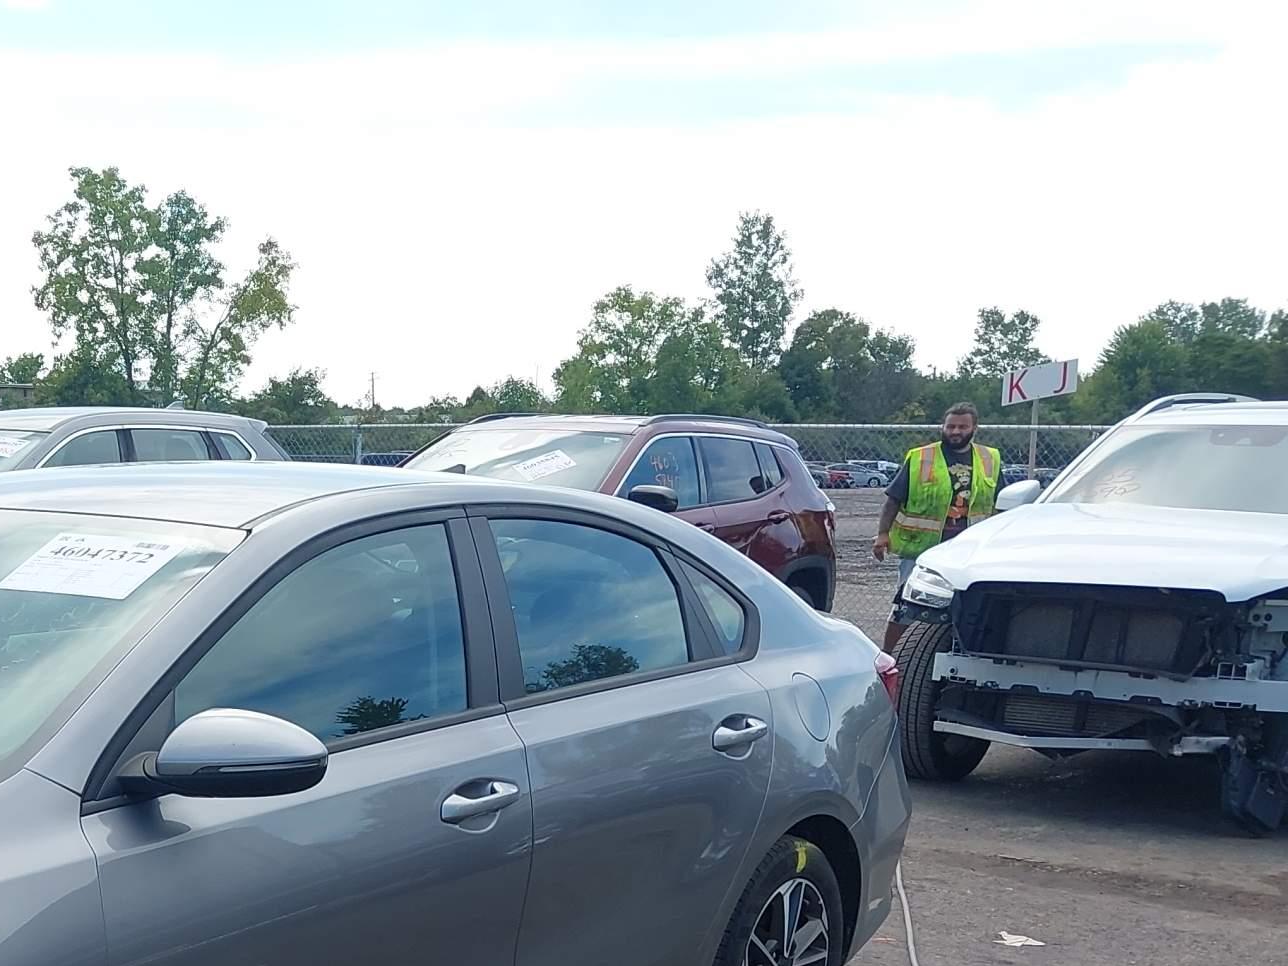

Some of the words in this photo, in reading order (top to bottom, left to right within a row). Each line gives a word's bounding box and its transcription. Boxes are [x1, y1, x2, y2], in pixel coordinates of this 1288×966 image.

[1008, 369, 1027, 403] K
[1052, 361, 1068, 394] J
[50, 545, 155, 564] 46047372
